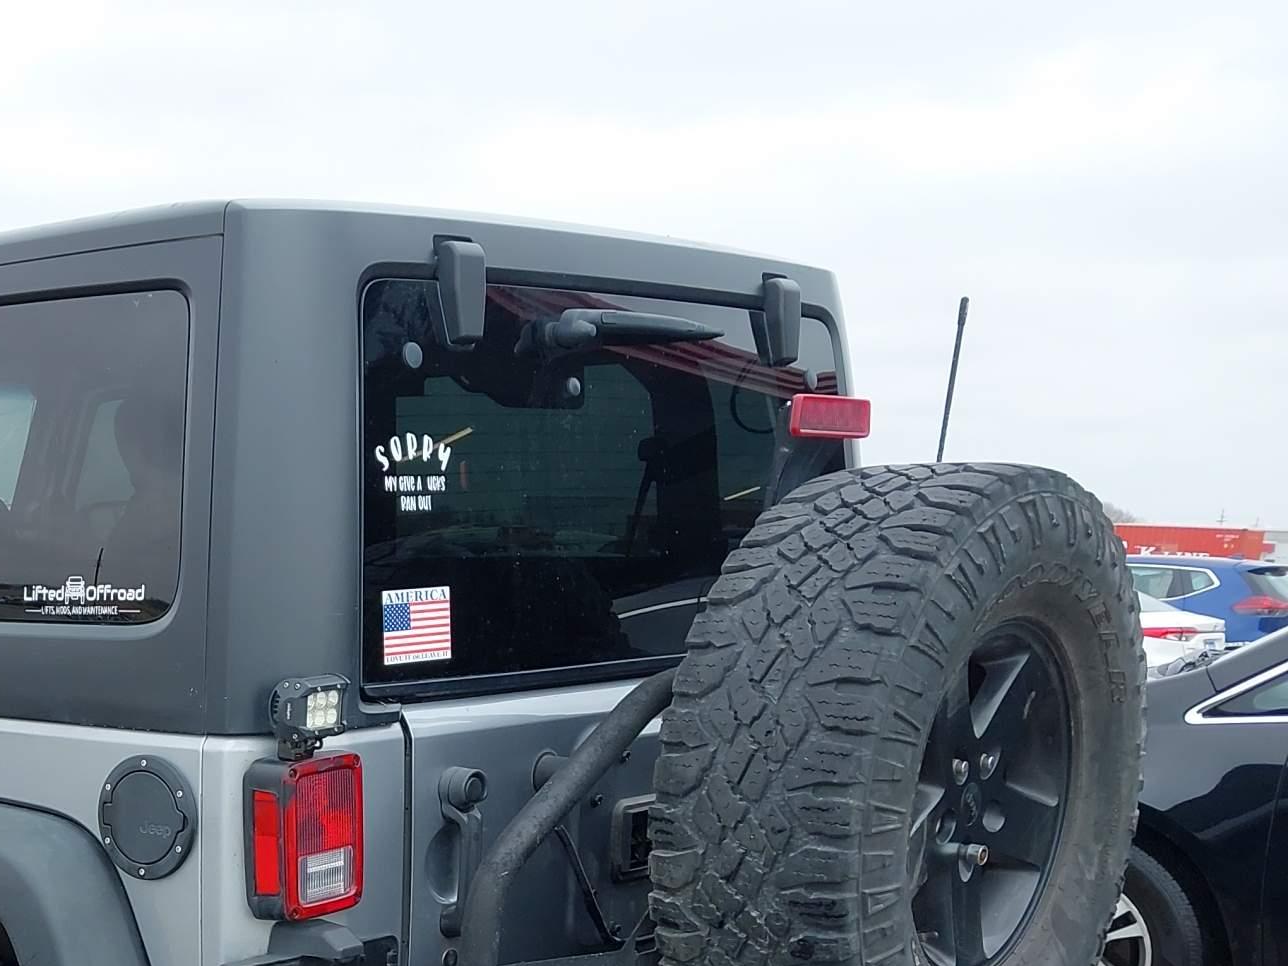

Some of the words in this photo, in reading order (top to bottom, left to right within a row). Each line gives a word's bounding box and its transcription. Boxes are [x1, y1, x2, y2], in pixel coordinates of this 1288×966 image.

[375, 432, 452, 472] SORRY
[384, 475, 398, 492] MY
[416, 476, 423, 492] A
[400, 495, 417, 511] RAN
[417, 495, 432, 511] OUT
[23, 585, 65, 602] Lifted
[86, 584, 146, 602] Offroad
[385, 588, 448, 605] AMERICA
